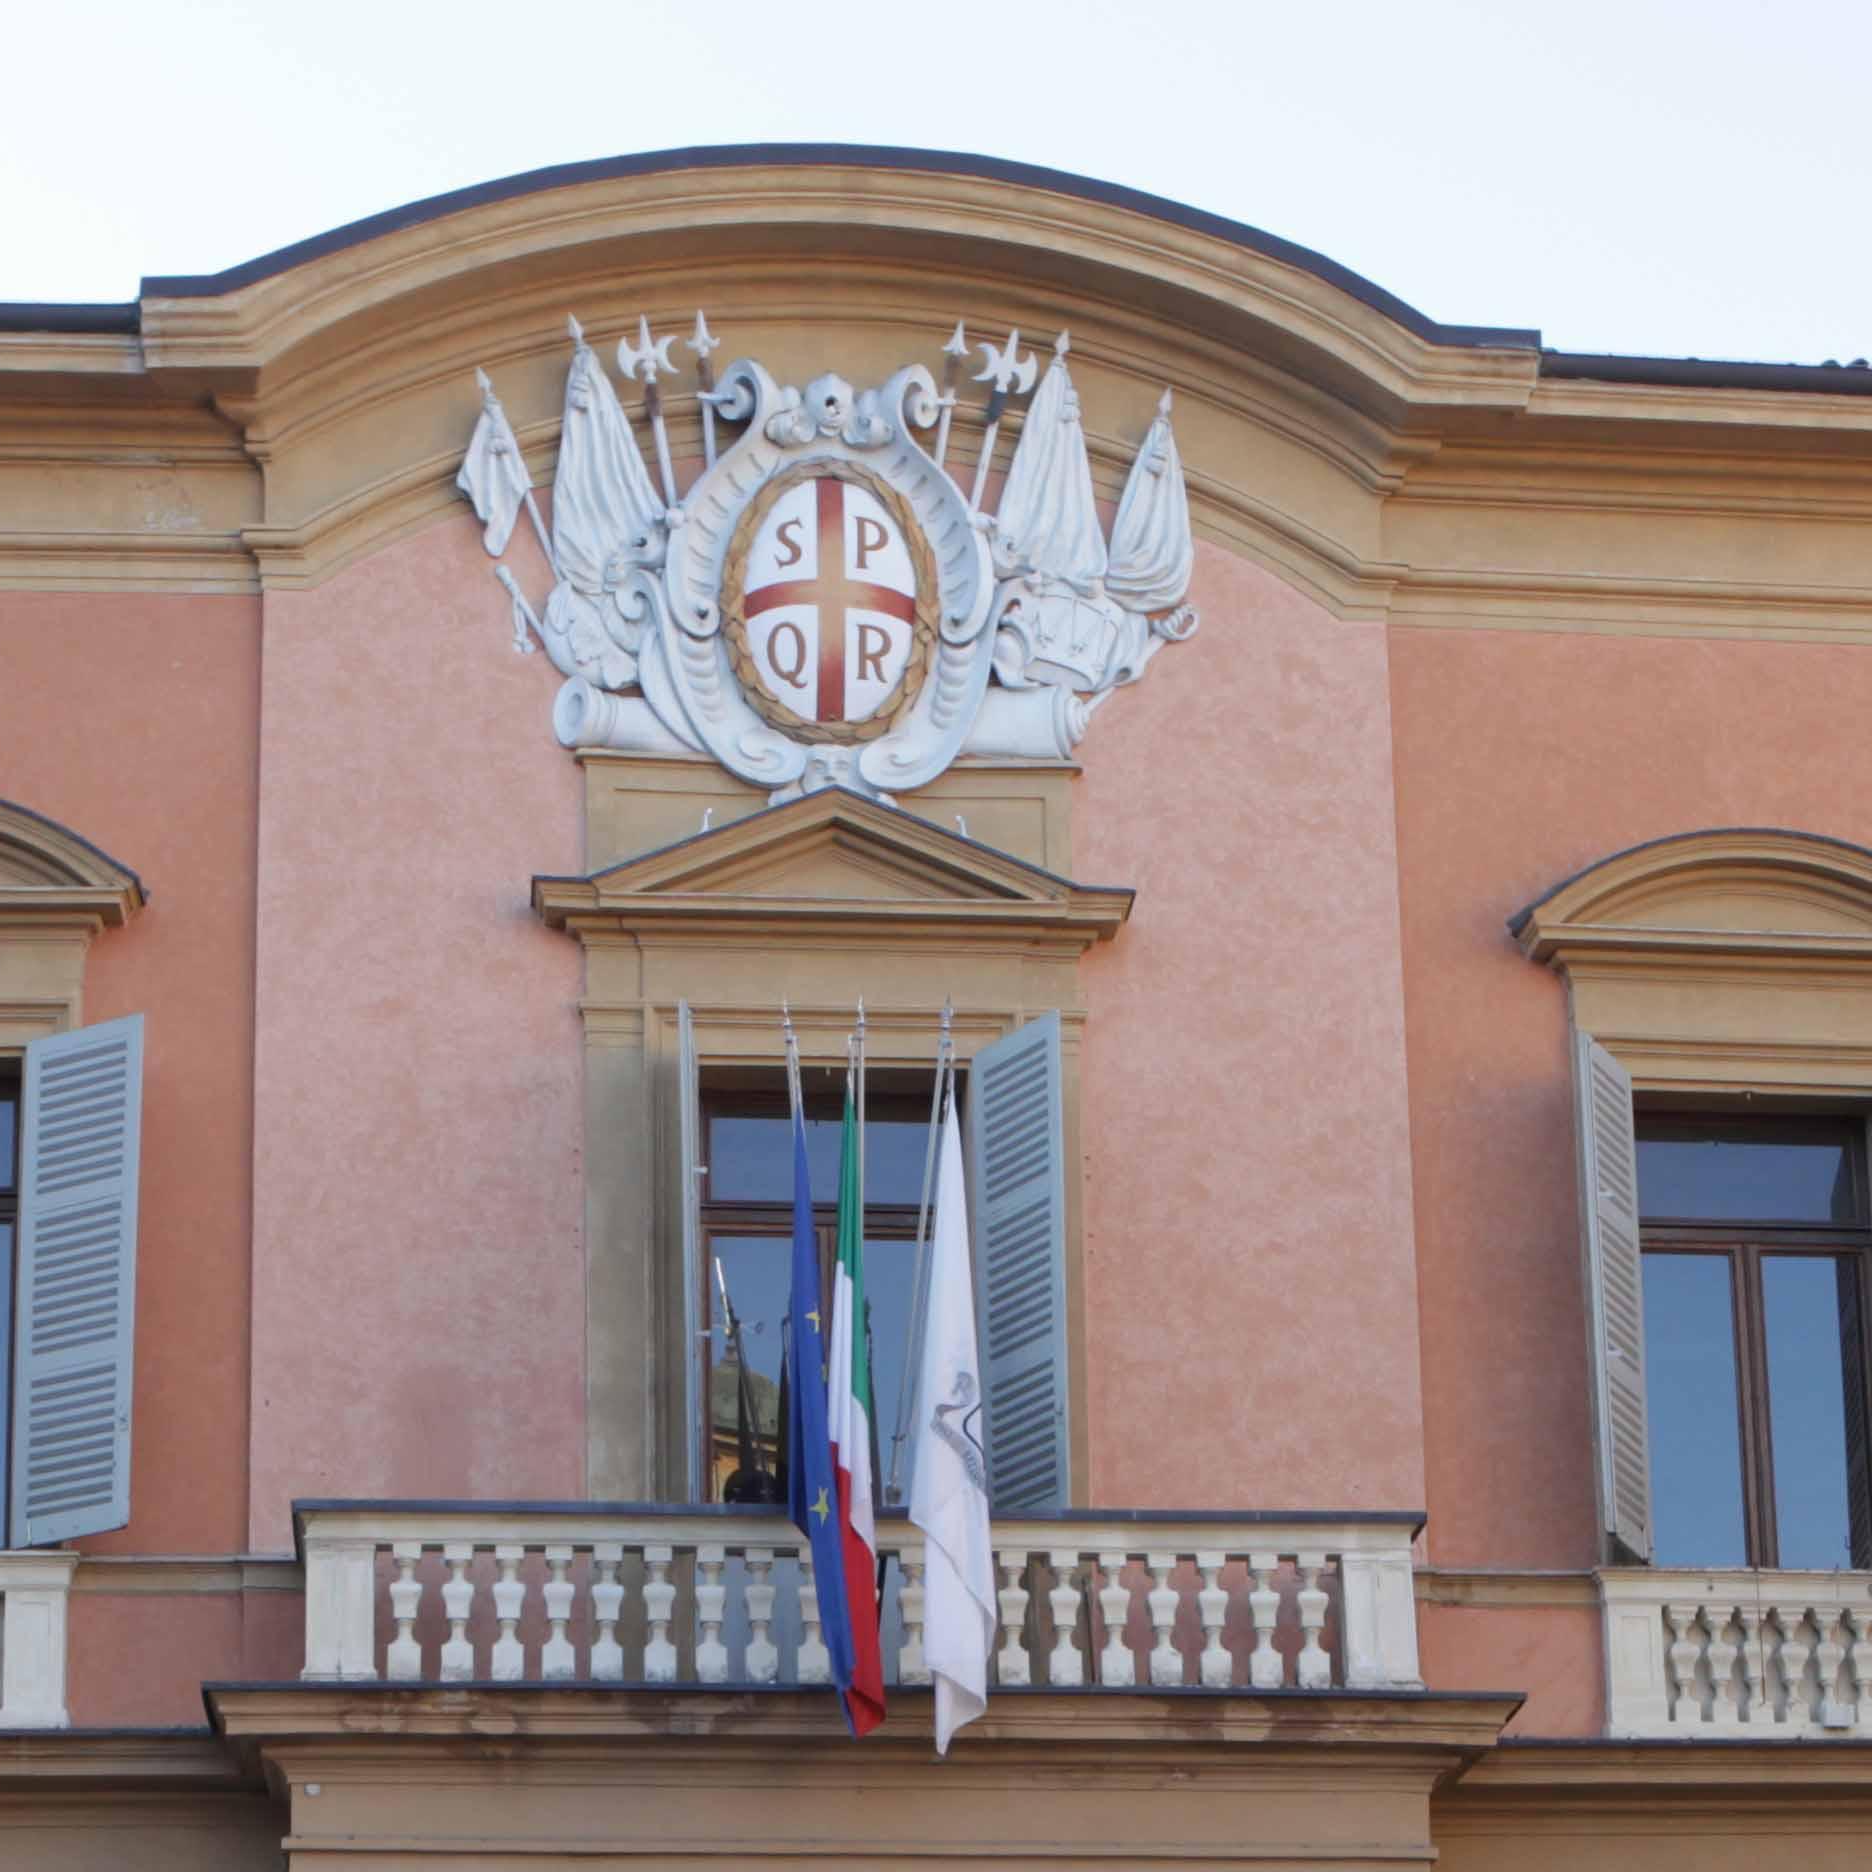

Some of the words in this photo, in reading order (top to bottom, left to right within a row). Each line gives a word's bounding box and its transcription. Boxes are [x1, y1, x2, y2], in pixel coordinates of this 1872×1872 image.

[774, 516, 803, 568] S
[855, 515, 889, 569] P
[766, 621, 808, 689] Q
[856, 623, 892, 684] R
